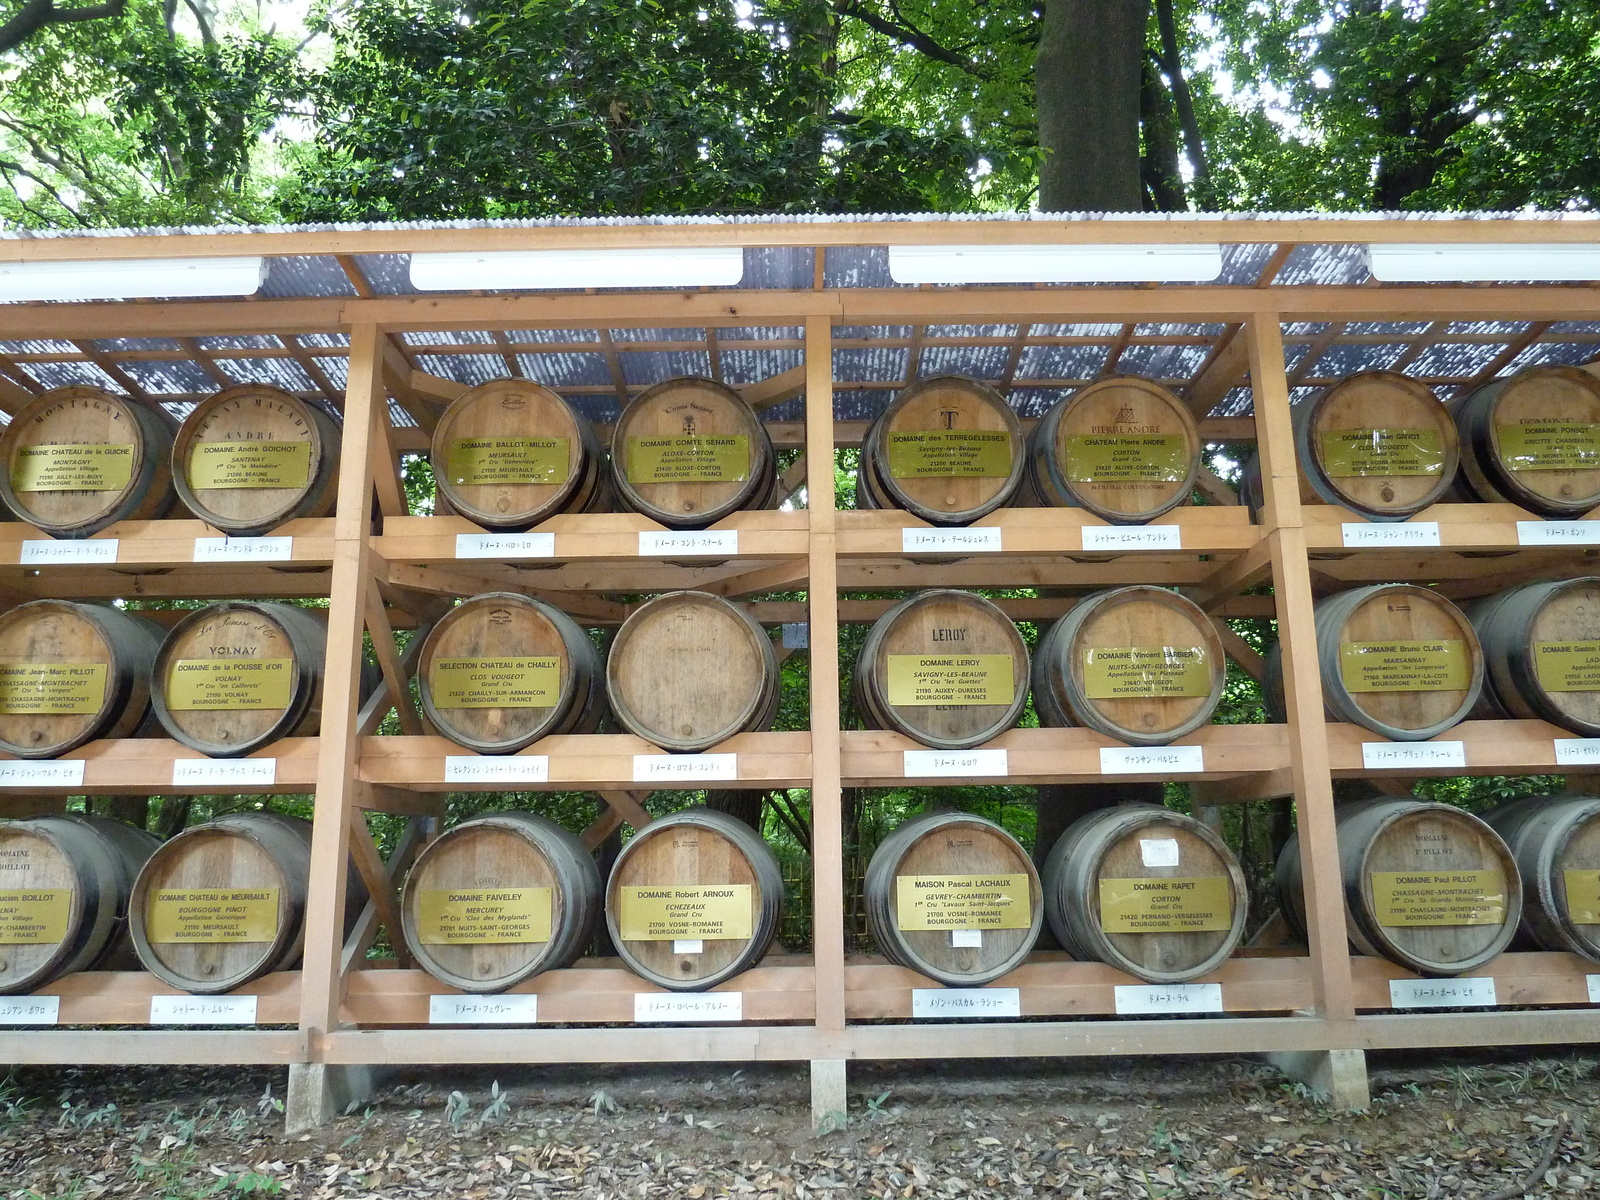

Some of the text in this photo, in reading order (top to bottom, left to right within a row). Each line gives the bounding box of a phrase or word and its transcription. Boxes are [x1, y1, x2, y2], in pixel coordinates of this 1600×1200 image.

[34, 400, 123, 424] MONTAGNY
[663, 405, 689, 414] Comte
[932, 629, 966, 641] LEROY
[209, 647, 257, 655] VOLNAY
